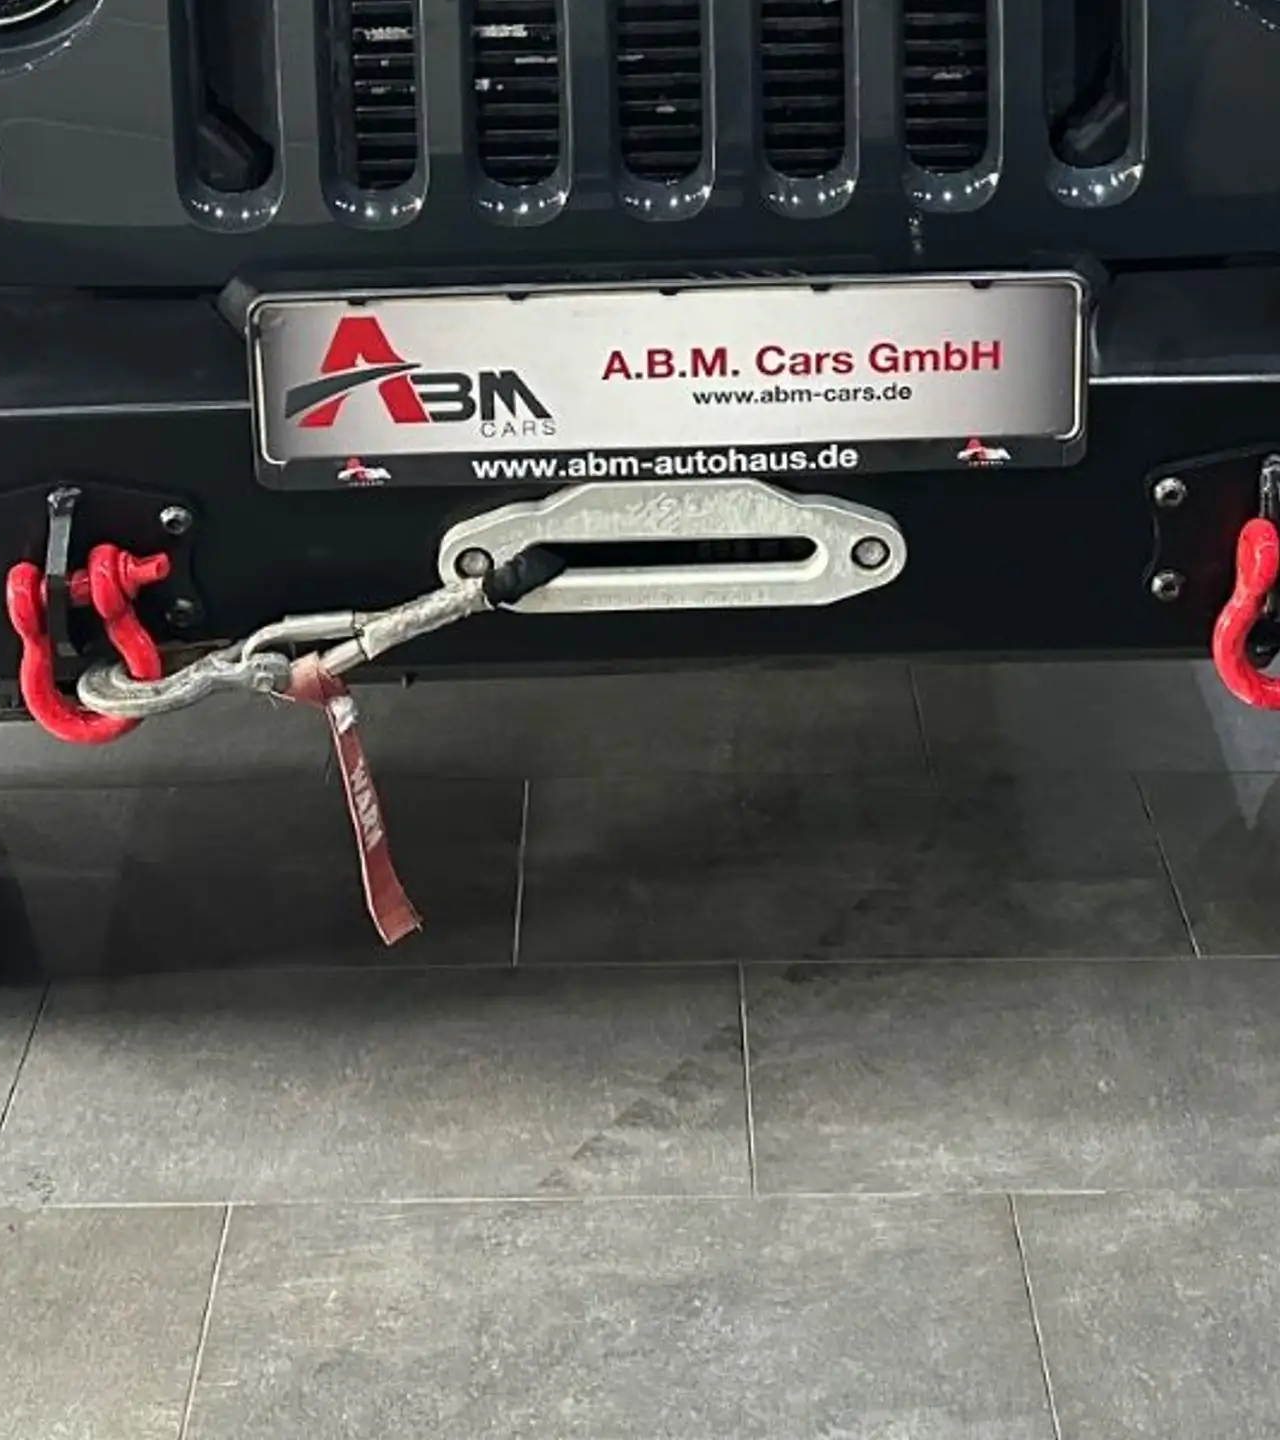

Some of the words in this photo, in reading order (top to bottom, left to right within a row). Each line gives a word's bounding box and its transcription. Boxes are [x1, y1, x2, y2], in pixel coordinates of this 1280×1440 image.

[285, 315, 554, 428] ABM
[601, 347, 741, 381] A.B.M.
[754, 344, 855, 377] Cars
[867, 340, 1002, 374] GmbH
[692, 382, 913, 406] www.abm-cars.de
[479, 419, 557, 439] CARS
[471, 444, 859, 479] www.abm-autohaus.de
